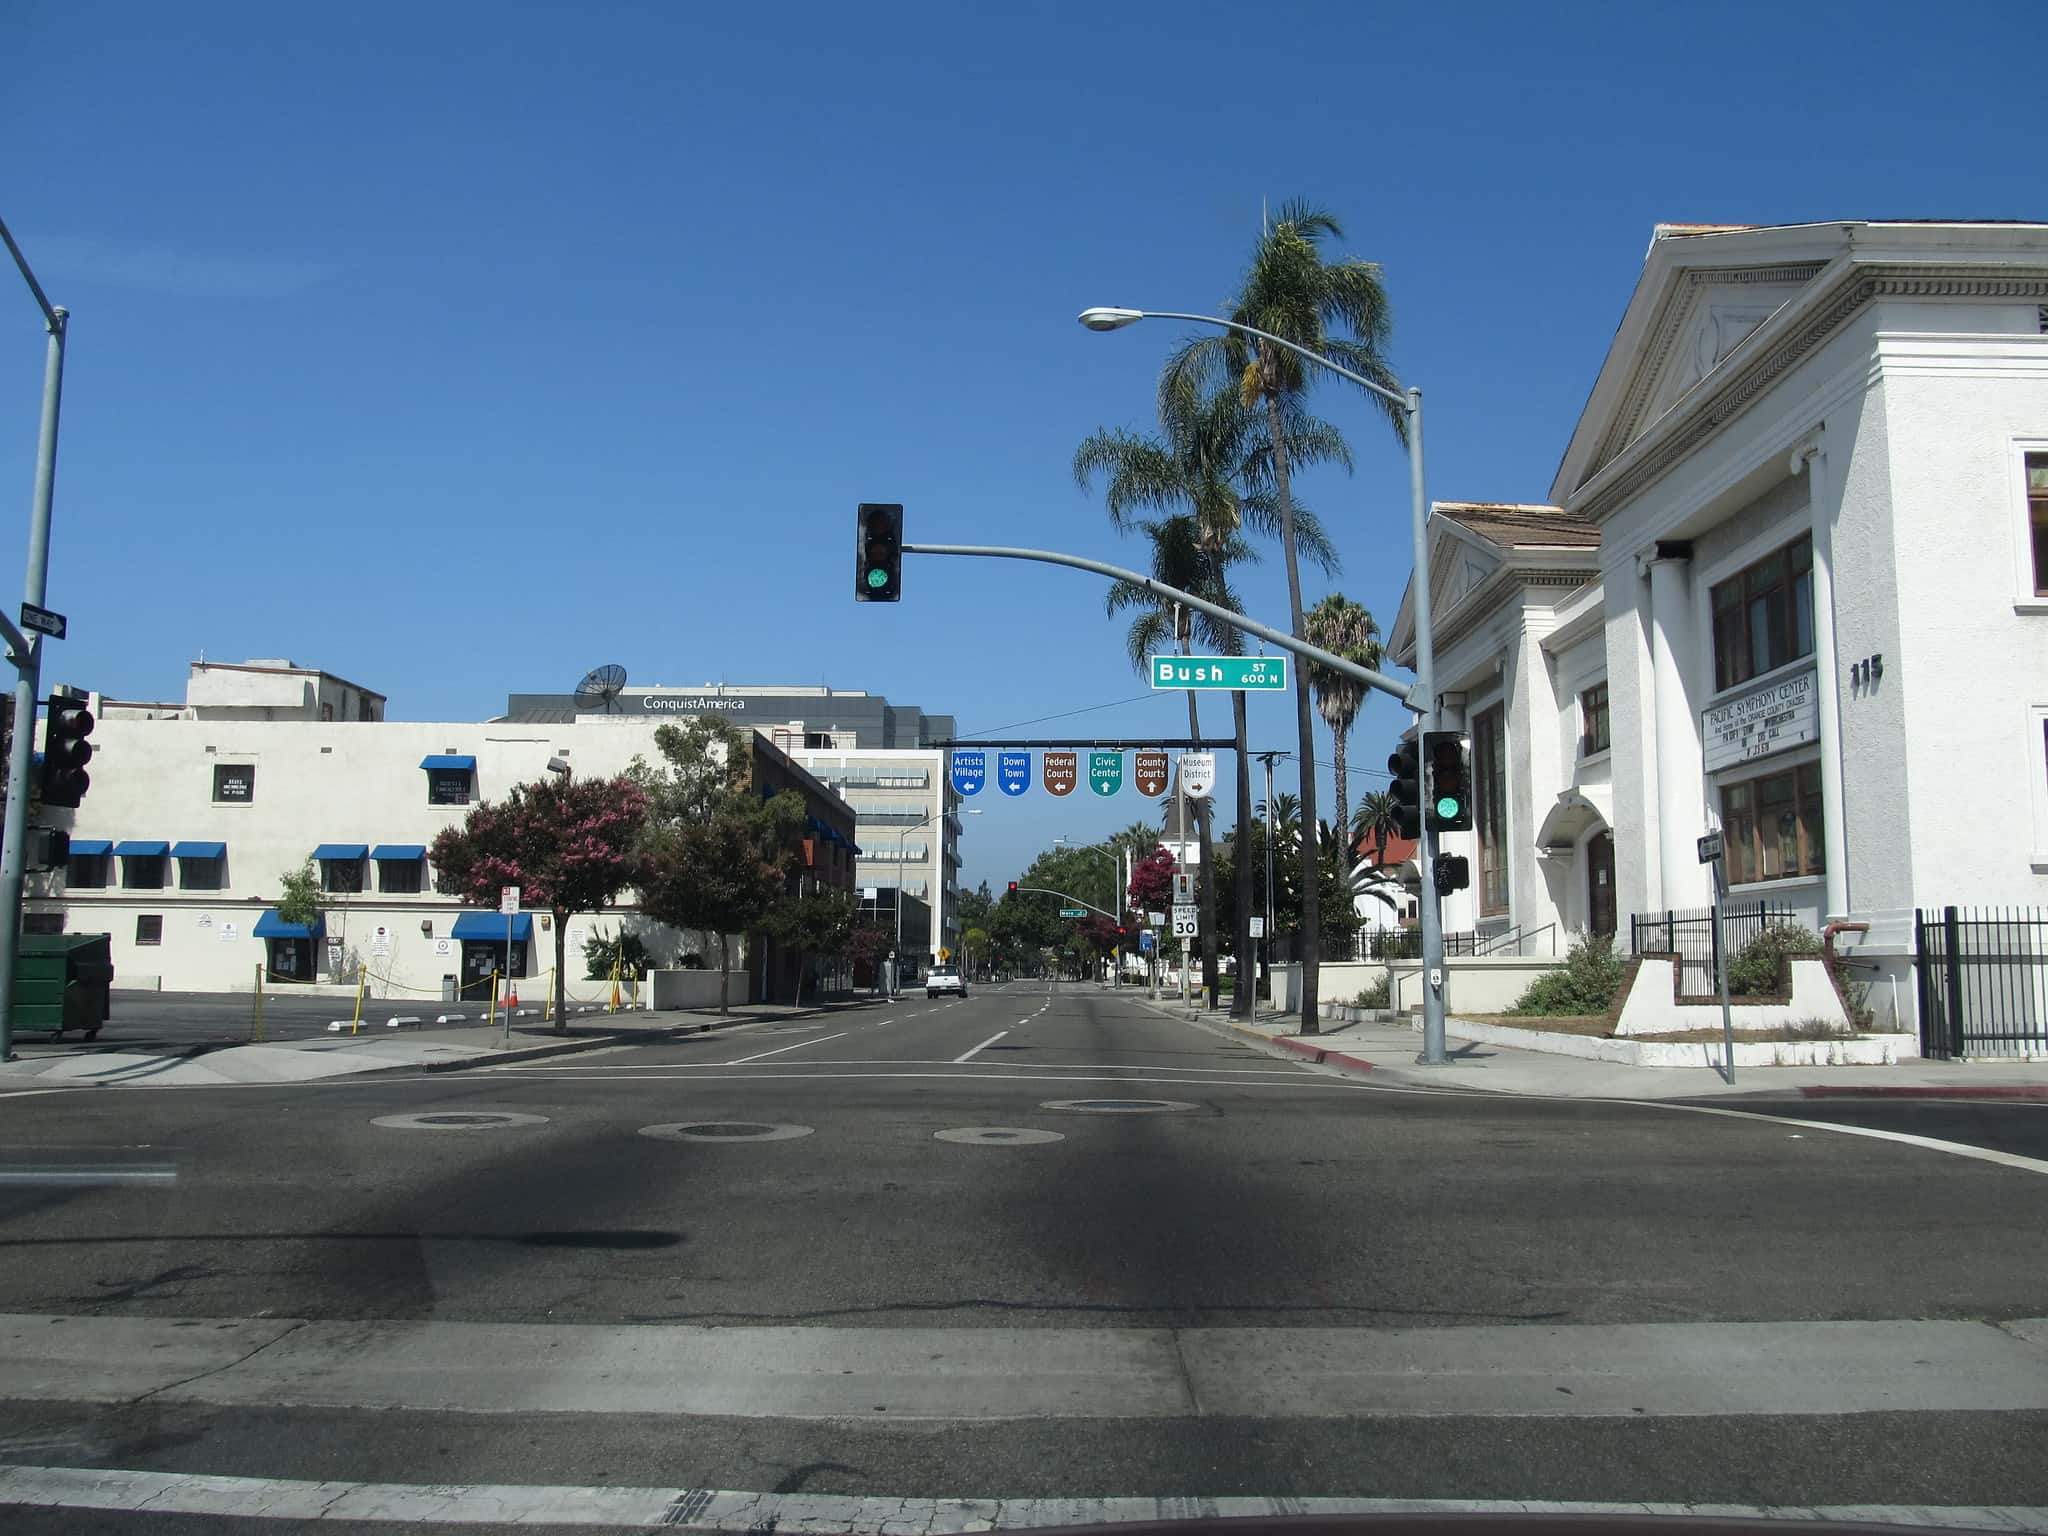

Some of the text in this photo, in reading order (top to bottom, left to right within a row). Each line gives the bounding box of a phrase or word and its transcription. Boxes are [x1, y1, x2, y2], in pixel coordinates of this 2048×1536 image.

[1252, 663, 1266, 672] ST
[1851, 654, 1883, 688] 115
[1160, 664, 1223, 681] Bush
[1241, 674, 1278, 683] 600 N
[1737, 688, 1776, 716] SYMPHONY
[1779, 676, 1810, 700] CENTER
[643, 696, 745, 711] ConquistAmerica
[954, 757, 983, 766] Artists
[1003, 757, 1025, 766] Down
[1045, 757, 1075, 766] Federal
[1095, 757, 1116, 766] Civic
[1137, 758, 1166, 768] County
[1183, 758, 1212, 767] Museum
[954, 768, 983, 778] Village
[1005, 769, 1024, 778] Town
[1047, 769, 1073, 778] Courts
[1091, 769, 1120, 777] Center
[1138, 769, 1165, 778] Courts
[1184, 769, 1211, 778] District
[1176, 922, 1195, 934] 30
